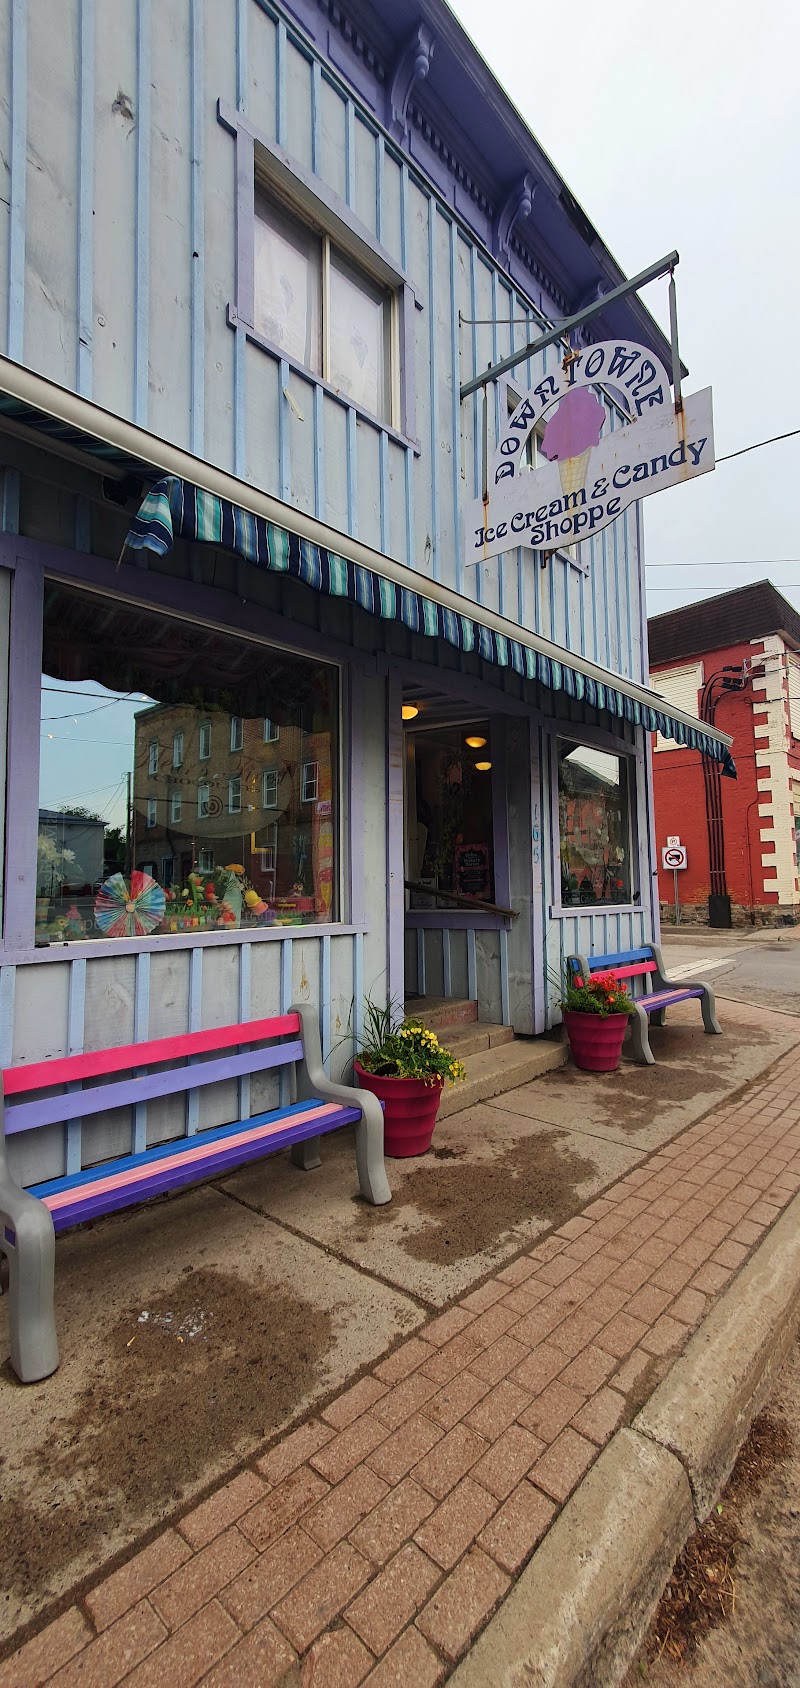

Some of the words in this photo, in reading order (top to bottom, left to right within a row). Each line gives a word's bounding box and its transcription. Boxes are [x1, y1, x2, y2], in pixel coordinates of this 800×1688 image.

[494, 346, 664, 485] DOWNTOWNE
[474, 520, 508, 548] Ice
[510, 485, 587, 533] Cream
[591, 477, 610, 500] &
[612, 437, 708, 489] Candy
[530, 496, 622, 546] Shoppe
